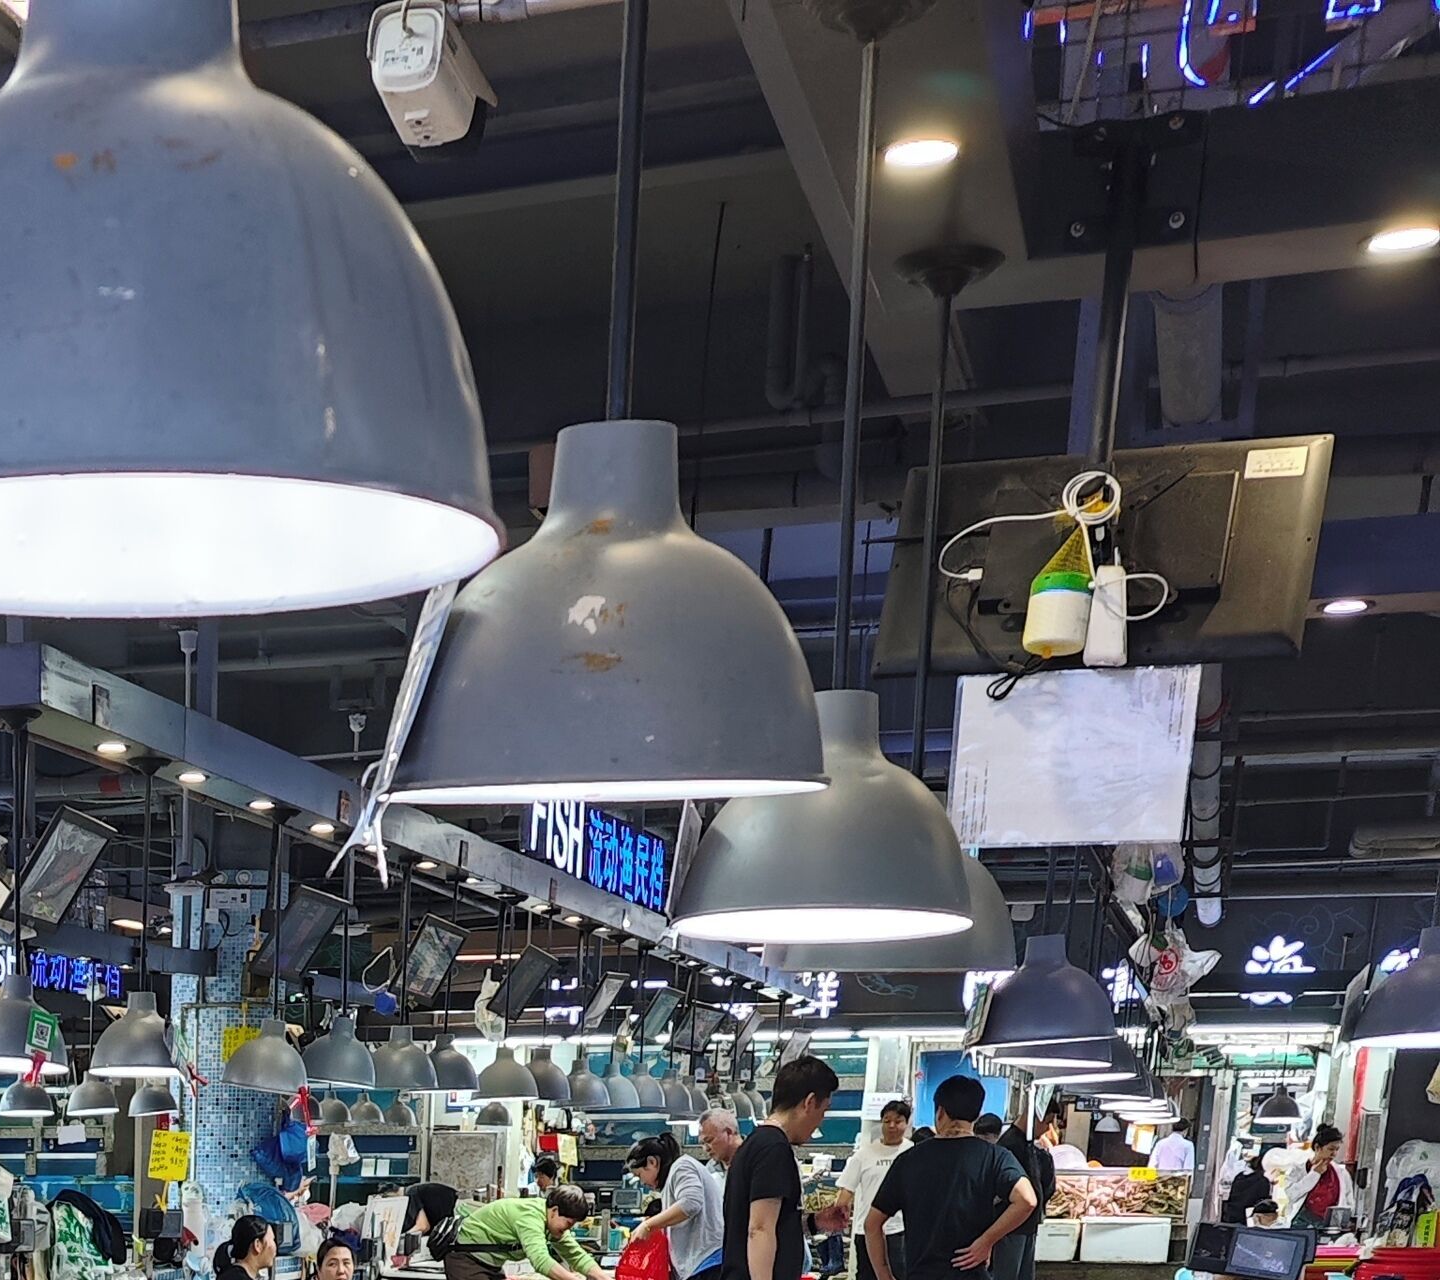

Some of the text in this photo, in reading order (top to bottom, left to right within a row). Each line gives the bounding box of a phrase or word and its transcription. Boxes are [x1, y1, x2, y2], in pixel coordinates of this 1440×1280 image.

[530, 799, 664, 911] FISH 流动渔民档
